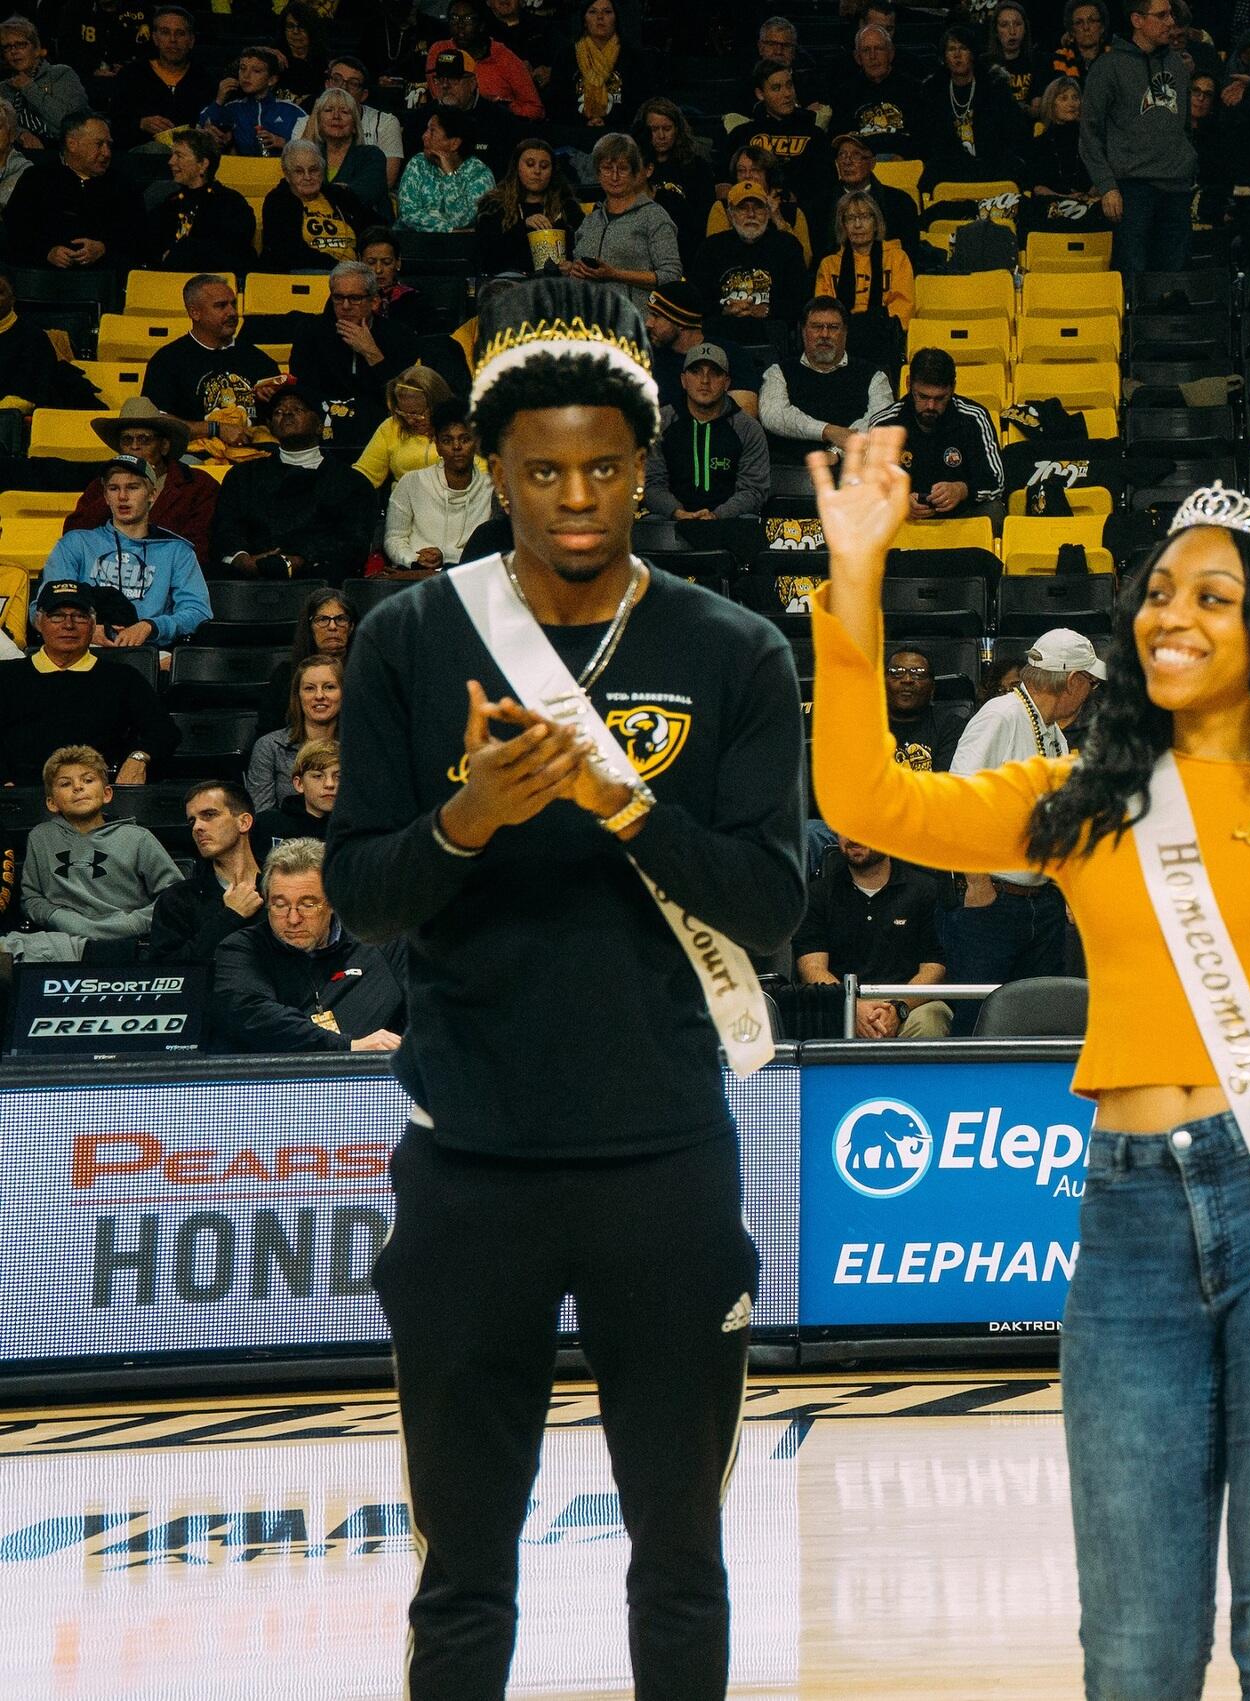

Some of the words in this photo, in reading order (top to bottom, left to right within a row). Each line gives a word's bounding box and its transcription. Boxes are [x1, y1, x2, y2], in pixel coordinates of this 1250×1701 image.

[759, 133, 812, 157] VCU
[306, 218, 338, 237] GO
[682, 910, 738, 998] Court
[151, 977, 185, 992] HD
[62, 994, 161, 1003] REPLAY
[31, 1016, 185, 1035] PRELOAD
[72, 1131, 394, 1190] PEARS
[1052, 1175, 1086, 1198] Au
[92, 1205, 394, 1310] HOND
[833, 1240, 1081, 1285] ELEPHAN
